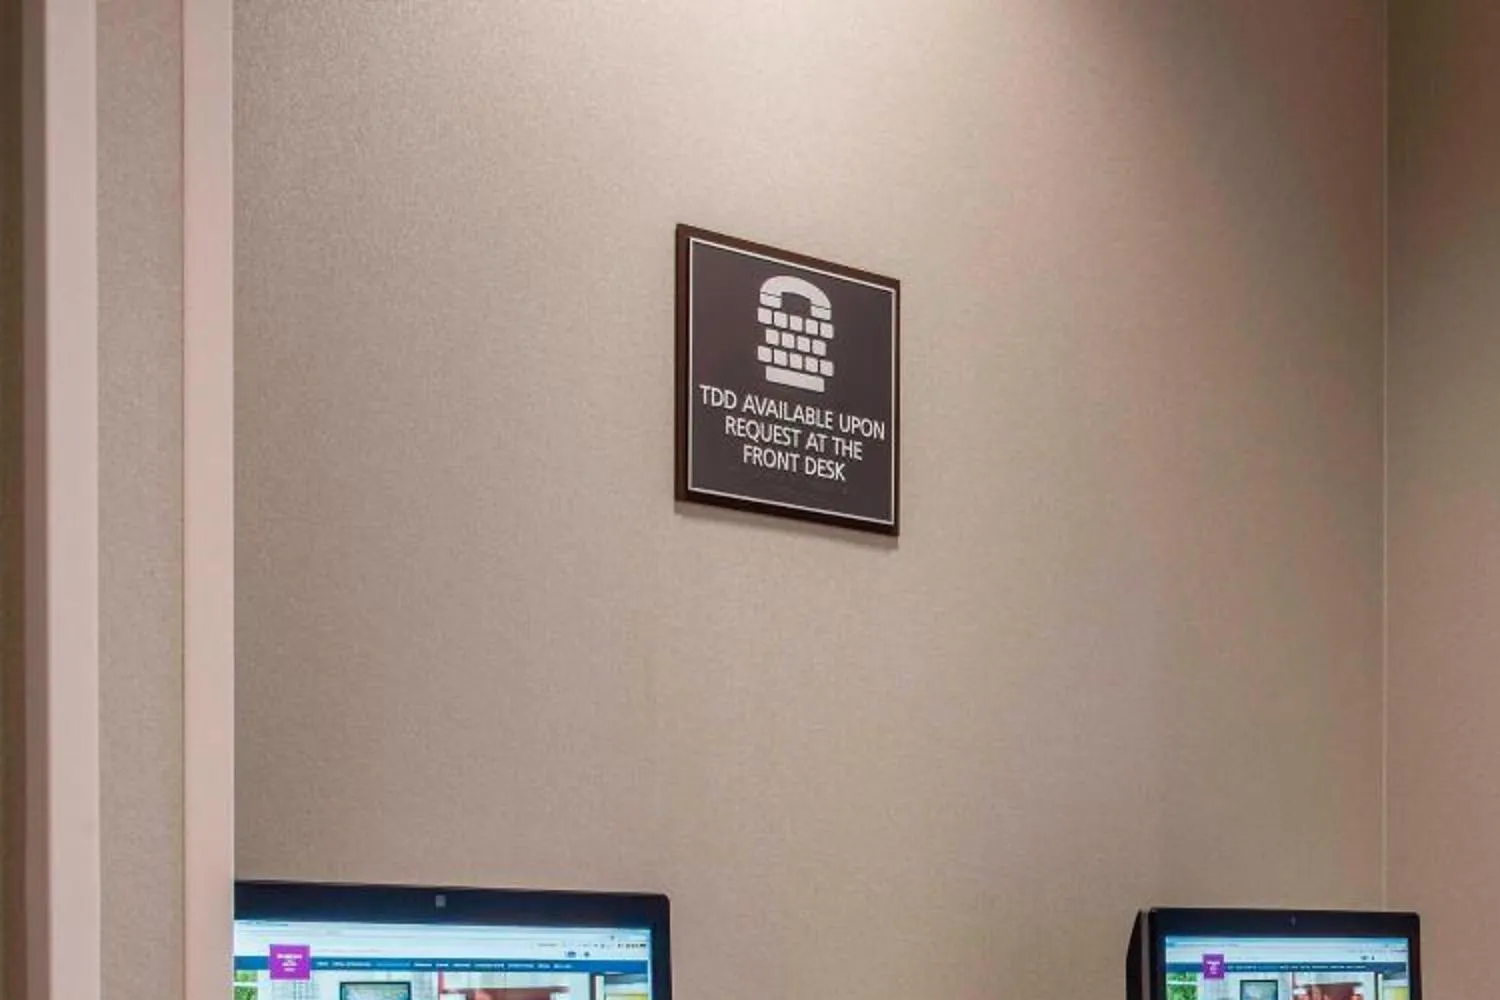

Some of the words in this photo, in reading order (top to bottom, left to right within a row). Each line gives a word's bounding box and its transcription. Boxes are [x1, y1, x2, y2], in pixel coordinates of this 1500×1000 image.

[699, 384, 737, 409] TDD
[742, 394, 833, 430] AVAILABLE
[839, 414, 885, 440] UPON
[725, 416, 802, 448] REQUEST
[805, 433, 828, 453] AT
[832, 436, 863, 461] THE
[743, 444, 800, 472] FRONT
[805, 456, 846, 481] DESK
